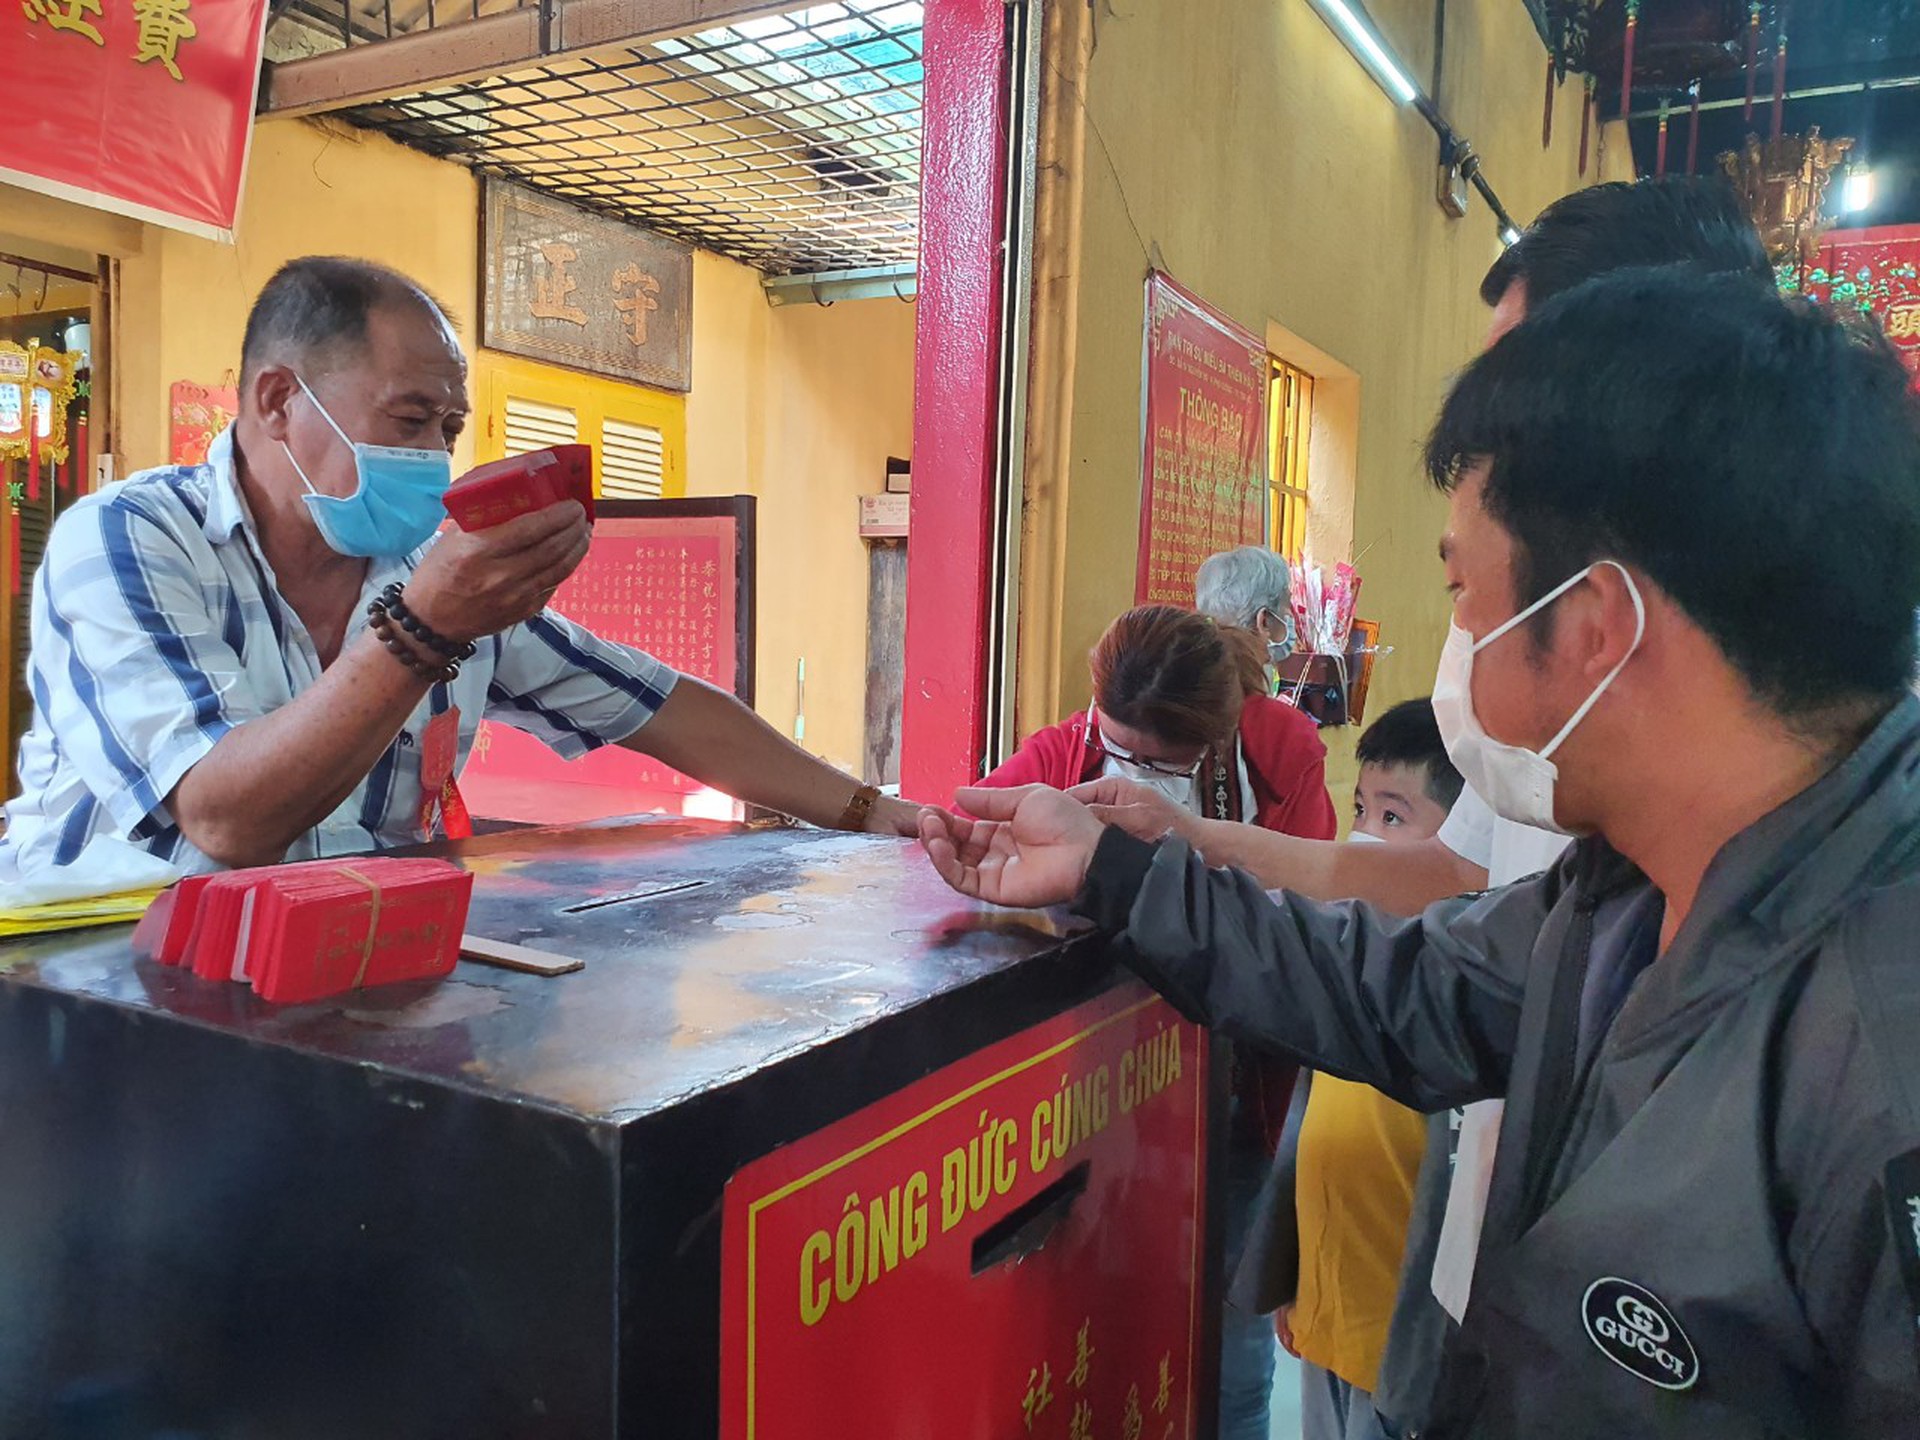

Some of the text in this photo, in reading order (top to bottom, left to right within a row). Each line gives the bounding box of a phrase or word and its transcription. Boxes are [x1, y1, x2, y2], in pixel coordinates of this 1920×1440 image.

[1180, 387, 1219, 429] THÔNG
[800, 1021, 1182, 1326] CÔNG ĐỨC CÚNG CHÙA
[1595, 1316, 1685, 1379] GUCCI
